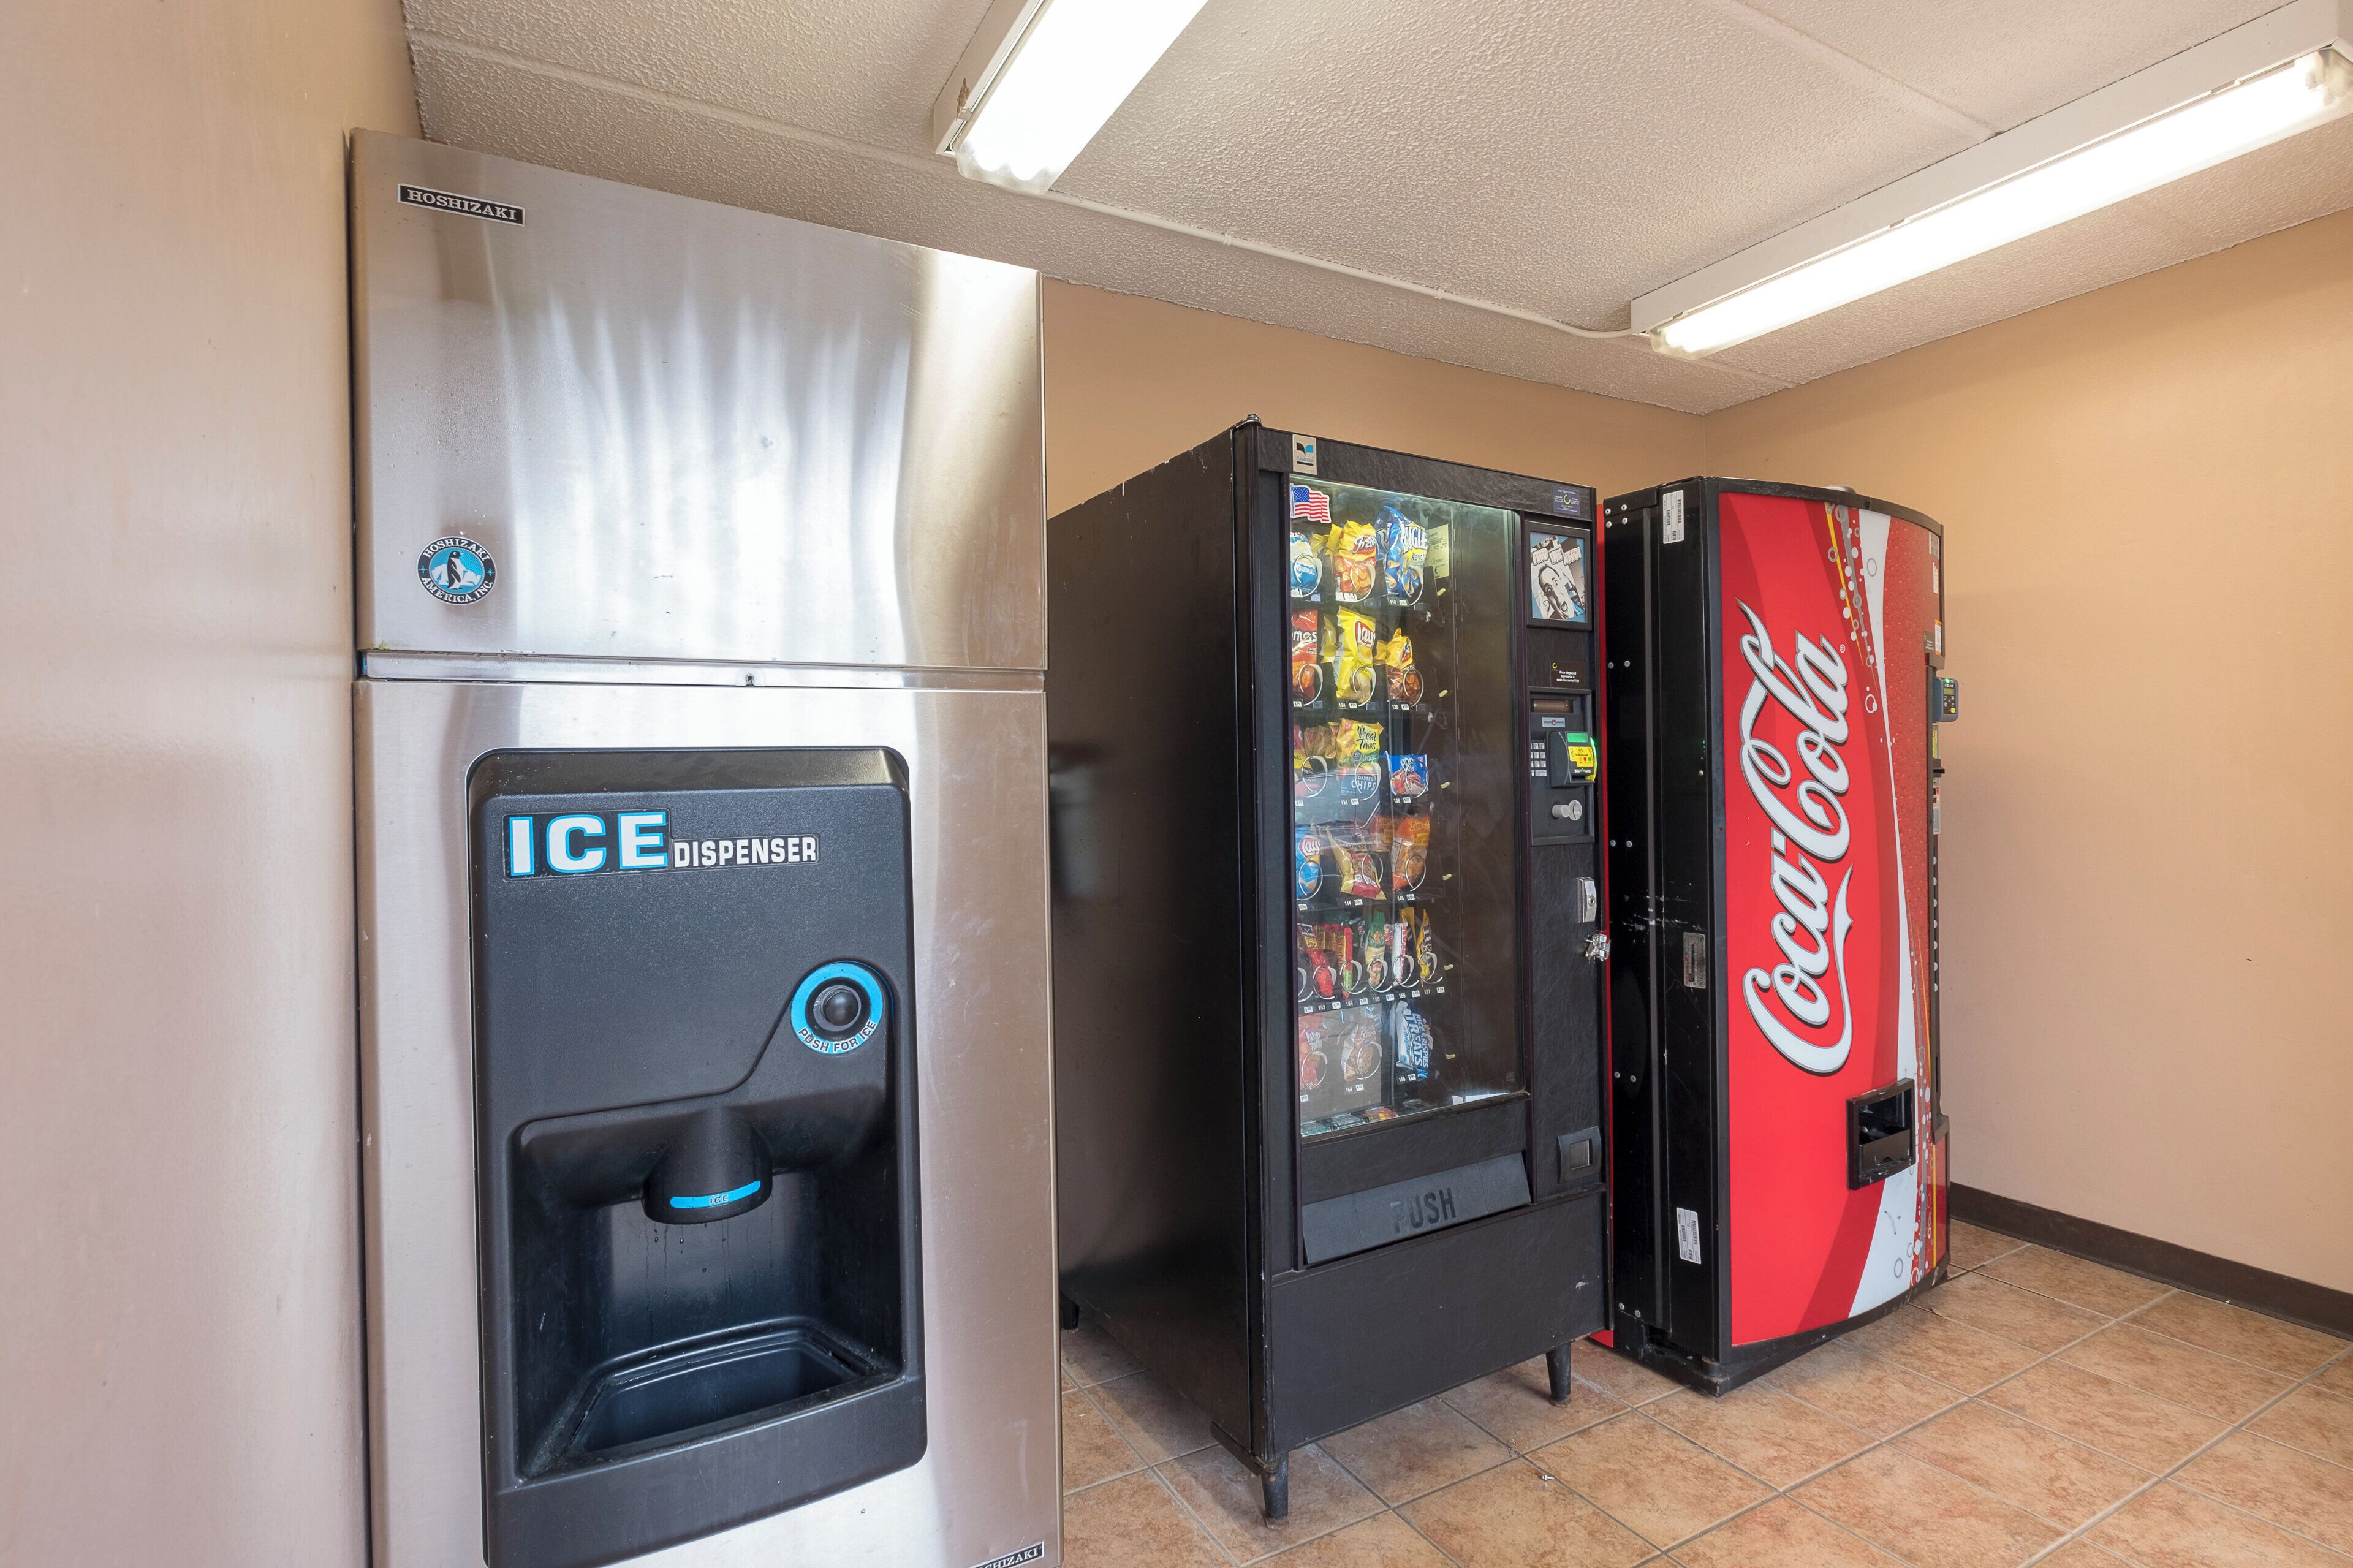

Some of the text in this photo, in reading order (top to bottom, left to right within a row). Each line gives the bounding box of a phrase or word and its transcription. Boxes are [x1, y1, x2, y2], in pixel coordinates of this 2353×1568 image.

[407, 189, 517, 221] HOSHIZAKI
[423, 539, 491, 562] HOSHIZAKI
[474, 580, 493, 598] INC.
[1356, 738, 1376, 750] Thins
[1357, 725, 1377, 741] Wheat
[1351, 779, 1376, 790] CHIPS
[509, 812, 817, 876] ICE DISPENSER
[1735, 596, 1854, 1076] Coca-Cola
[1415, 1013, 1425, 1033] RICE
[798, 1020, 877, 1052] PUSH FOR ICE
[1403, 1014, 1422, 1067] TREATS
[710, 1195, 728, 1204] ICE
[1391, 1187, 1456, 1234] PUSH
[980, 1547, 1039, 1568] SHIZAKI
